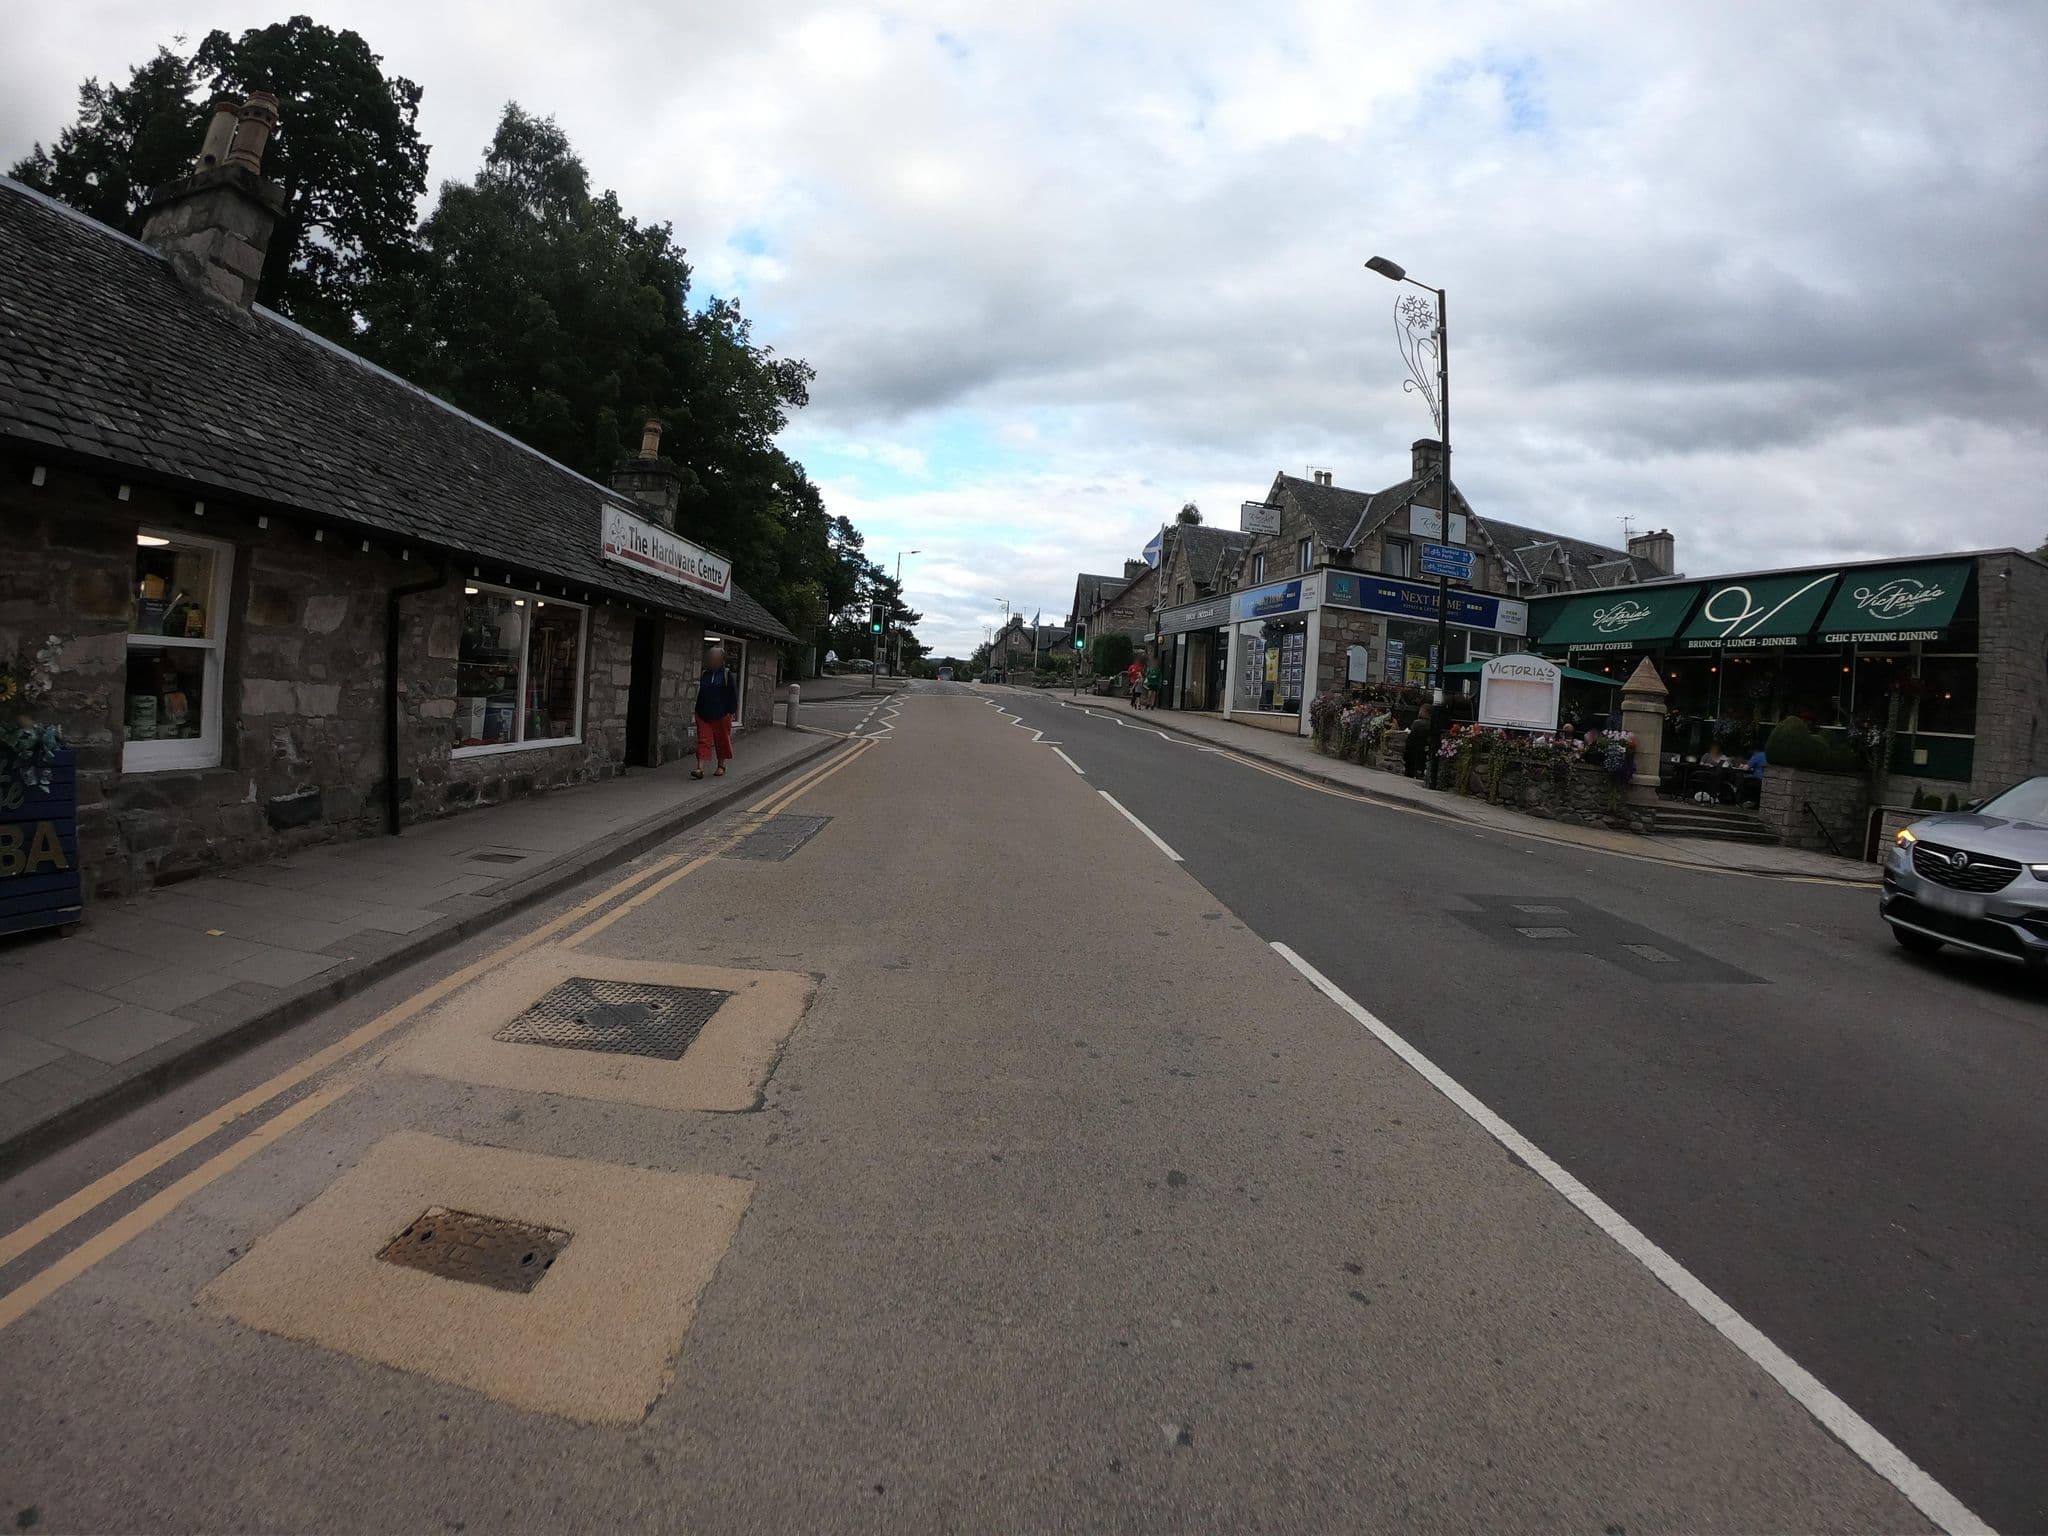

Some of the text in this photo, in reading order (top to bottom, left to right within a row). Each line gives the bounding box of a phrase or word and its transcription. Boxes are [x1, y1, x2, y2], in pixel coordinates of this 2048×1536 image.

[628, 526, 722, 585] The Hardware Centre
[1400, 589, 1430, 606] NEXT
[1431, 593, 1462, 612] HME
[1853, 583, 1945, 612] Victoria's
[1688, 640, 1722, 649] BRUNCH
[1727, 638, 1758, 648] LUNCH
[1761, 636, 1798, 647] DINNER
[1825, 630, 1939, 643] CHIC EVENING DINING
[1569, 641, 1633, 652] SPECIALITY COFFEES
[1488, 662, 1556, 679] VICTORIA'S
